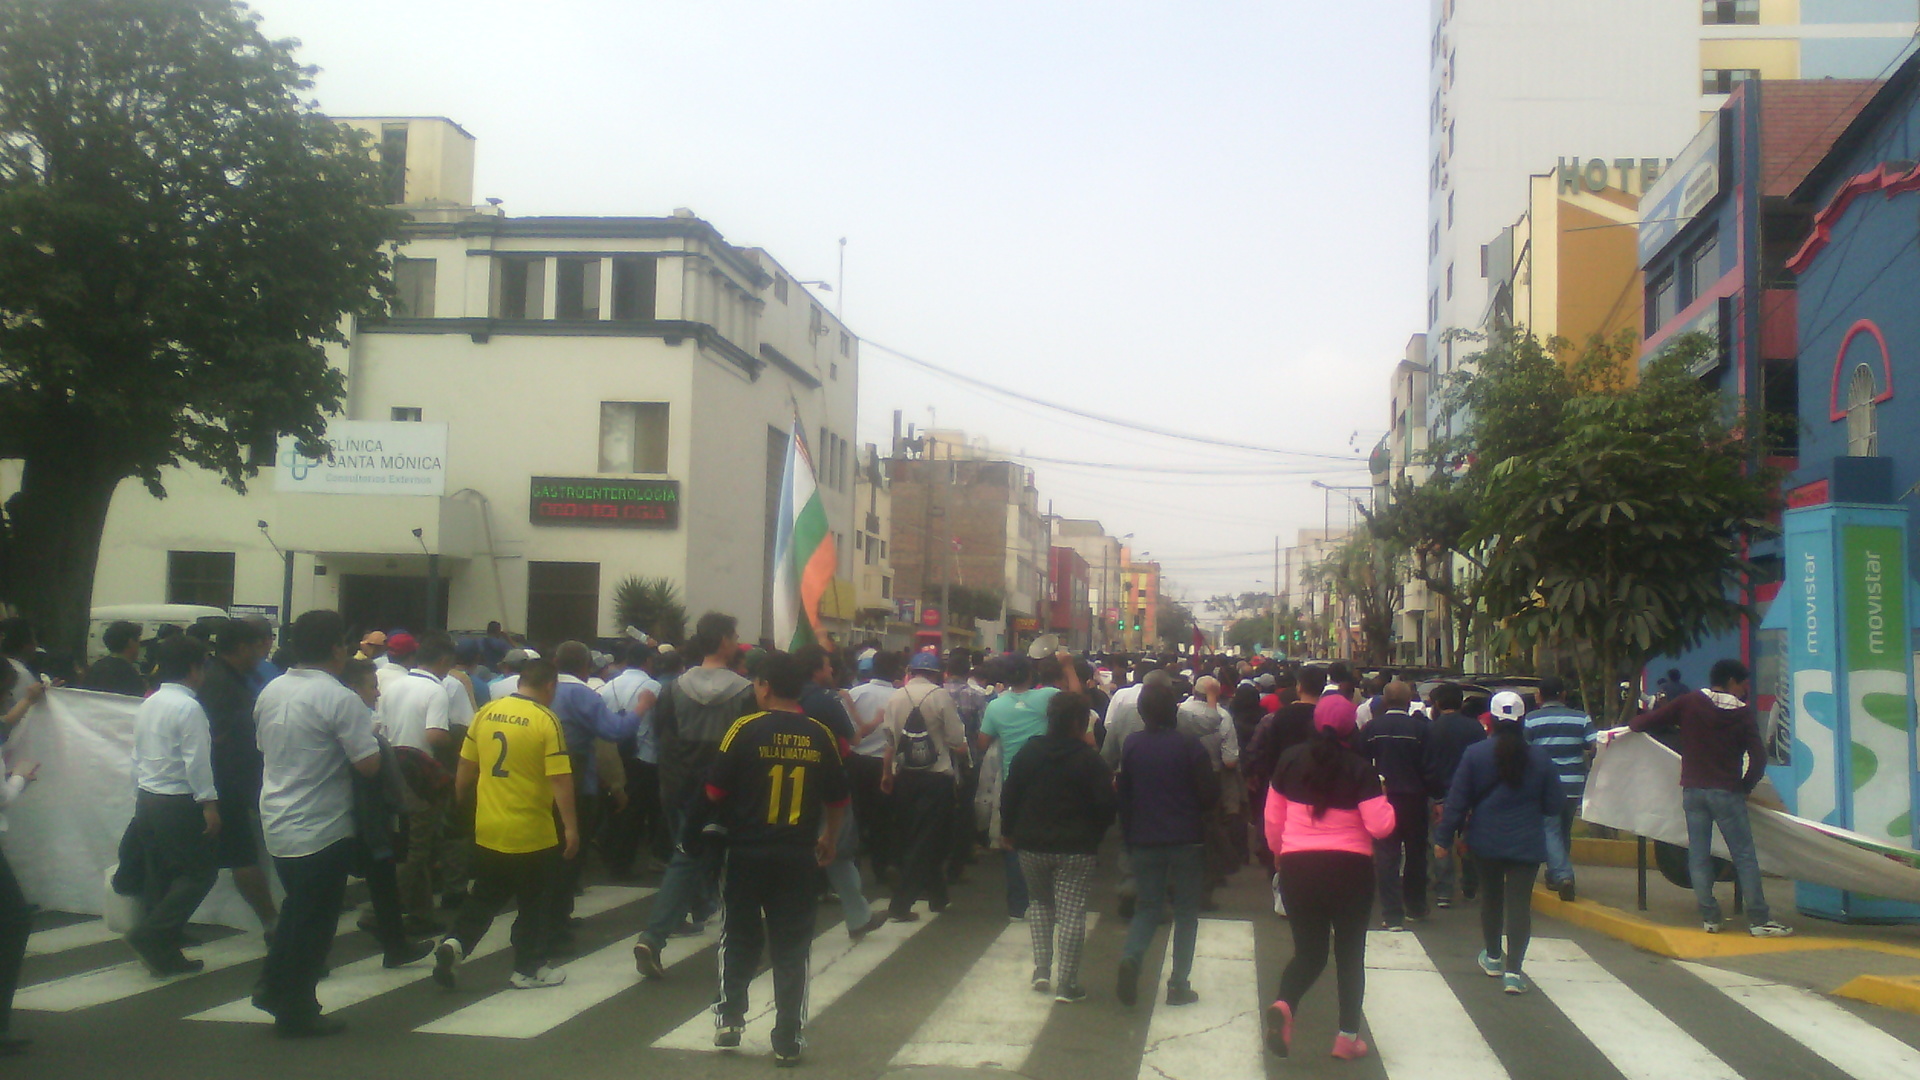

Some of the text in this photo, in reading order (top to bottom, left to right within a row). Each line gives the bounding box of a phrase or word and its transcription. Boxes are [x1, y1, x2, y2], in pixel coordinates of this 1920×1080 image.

[1558, 156, 1673, 195] HOTE
[327, 453, 441, 470] SANTA MÓNICA
[1805, 552, 1817, 654] movistar
[1866, 550, 1884, 654] movistar
[492, 731, 509, 777] 2
[767, 764, 805, 825] 11
